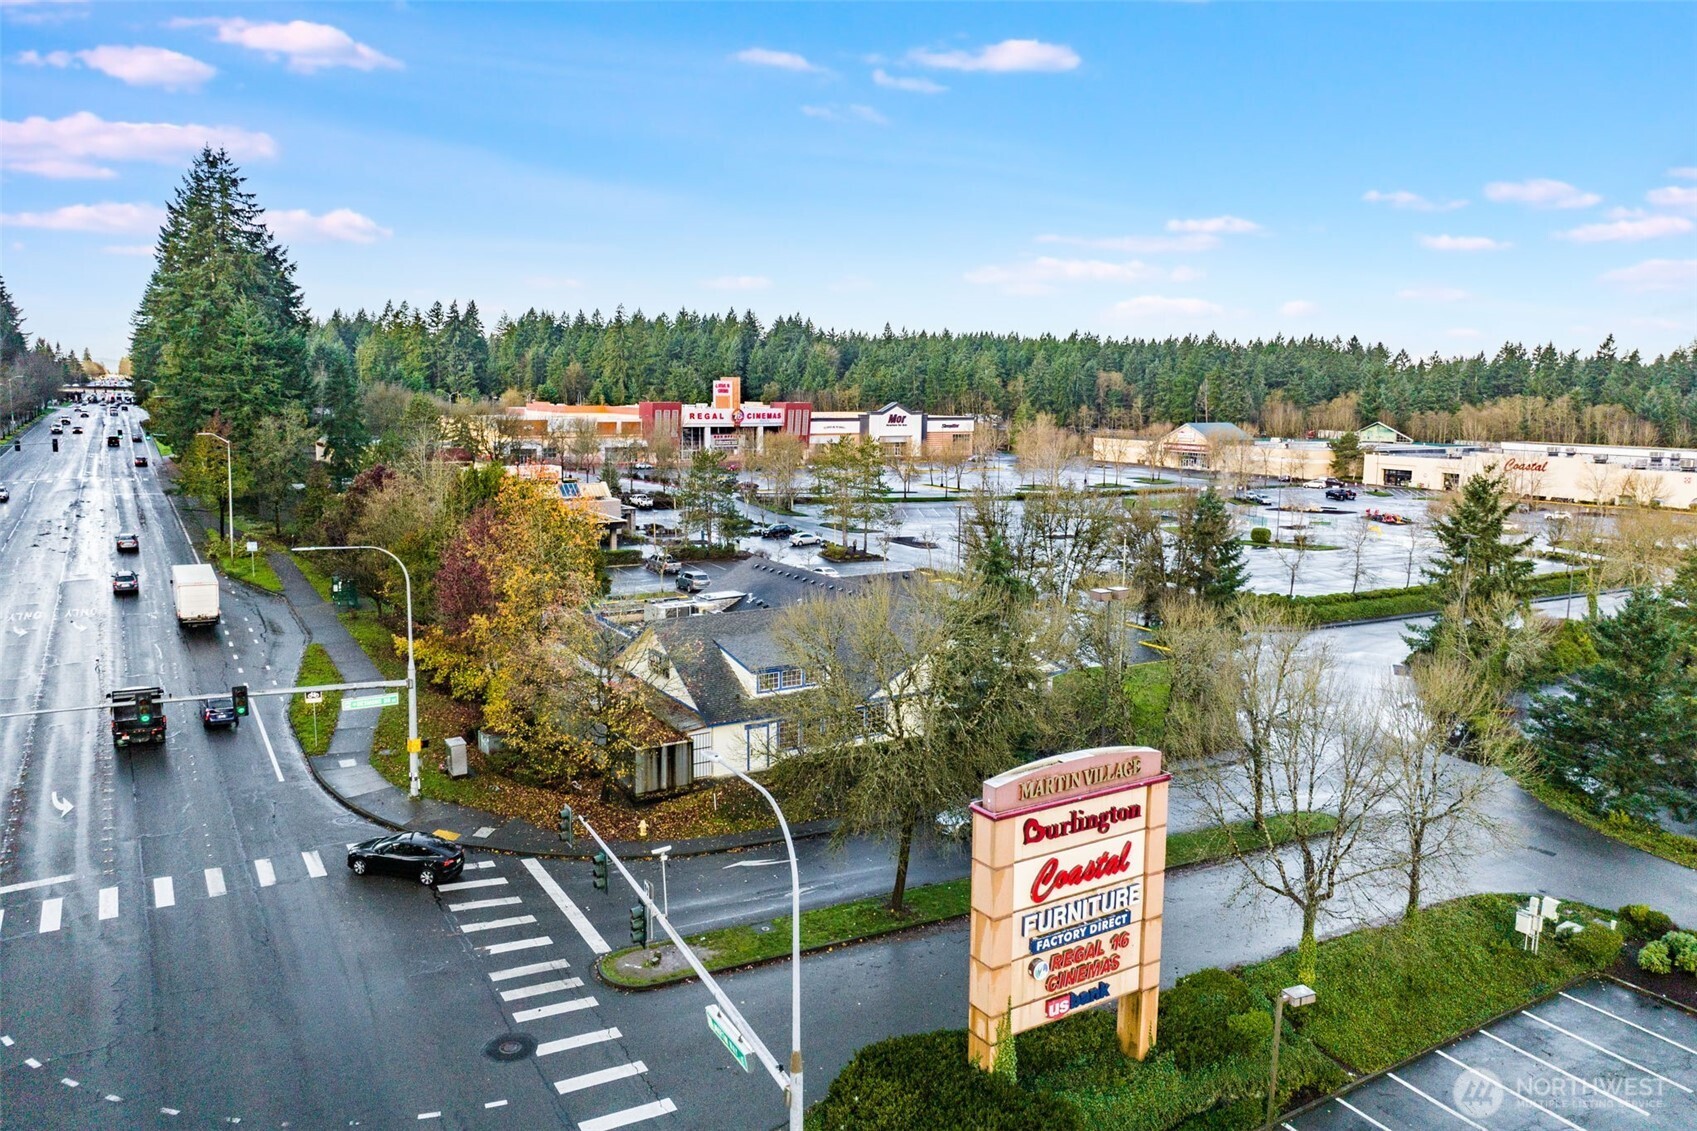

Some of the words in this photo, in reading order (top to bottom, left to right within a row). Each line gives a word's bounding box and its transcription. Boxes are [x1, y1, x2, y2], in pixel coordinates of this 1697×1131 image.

[689, 412, 725, 420] REGAL
[746, 412, 782, 420] CINEMAS
[888, 413, 907, 424] Mor
[1504, 458, 1549, 472] Coastal
[8, 611, 43, 622] ONLY
[65, 607, 97, 618] ONLY
[1018, 773, 1081, 801] MARTIN
[1083, 756, 1142, 787] VILLAGE
[1023, 804, 1142, 845] Burlington
[1030, 841, 1132, 903] Coastal
[1022, 883, 1141, 938] FURNITURE
[1036, 925, 1087, 951] FACTORY
[1089, 913, 1128, 935] DIRECT
[1050, 939, 1105, 972] REGAL
[1110, 931, 1130, 950] 16
[1045, 953, 1120, 992] CINEMAS
